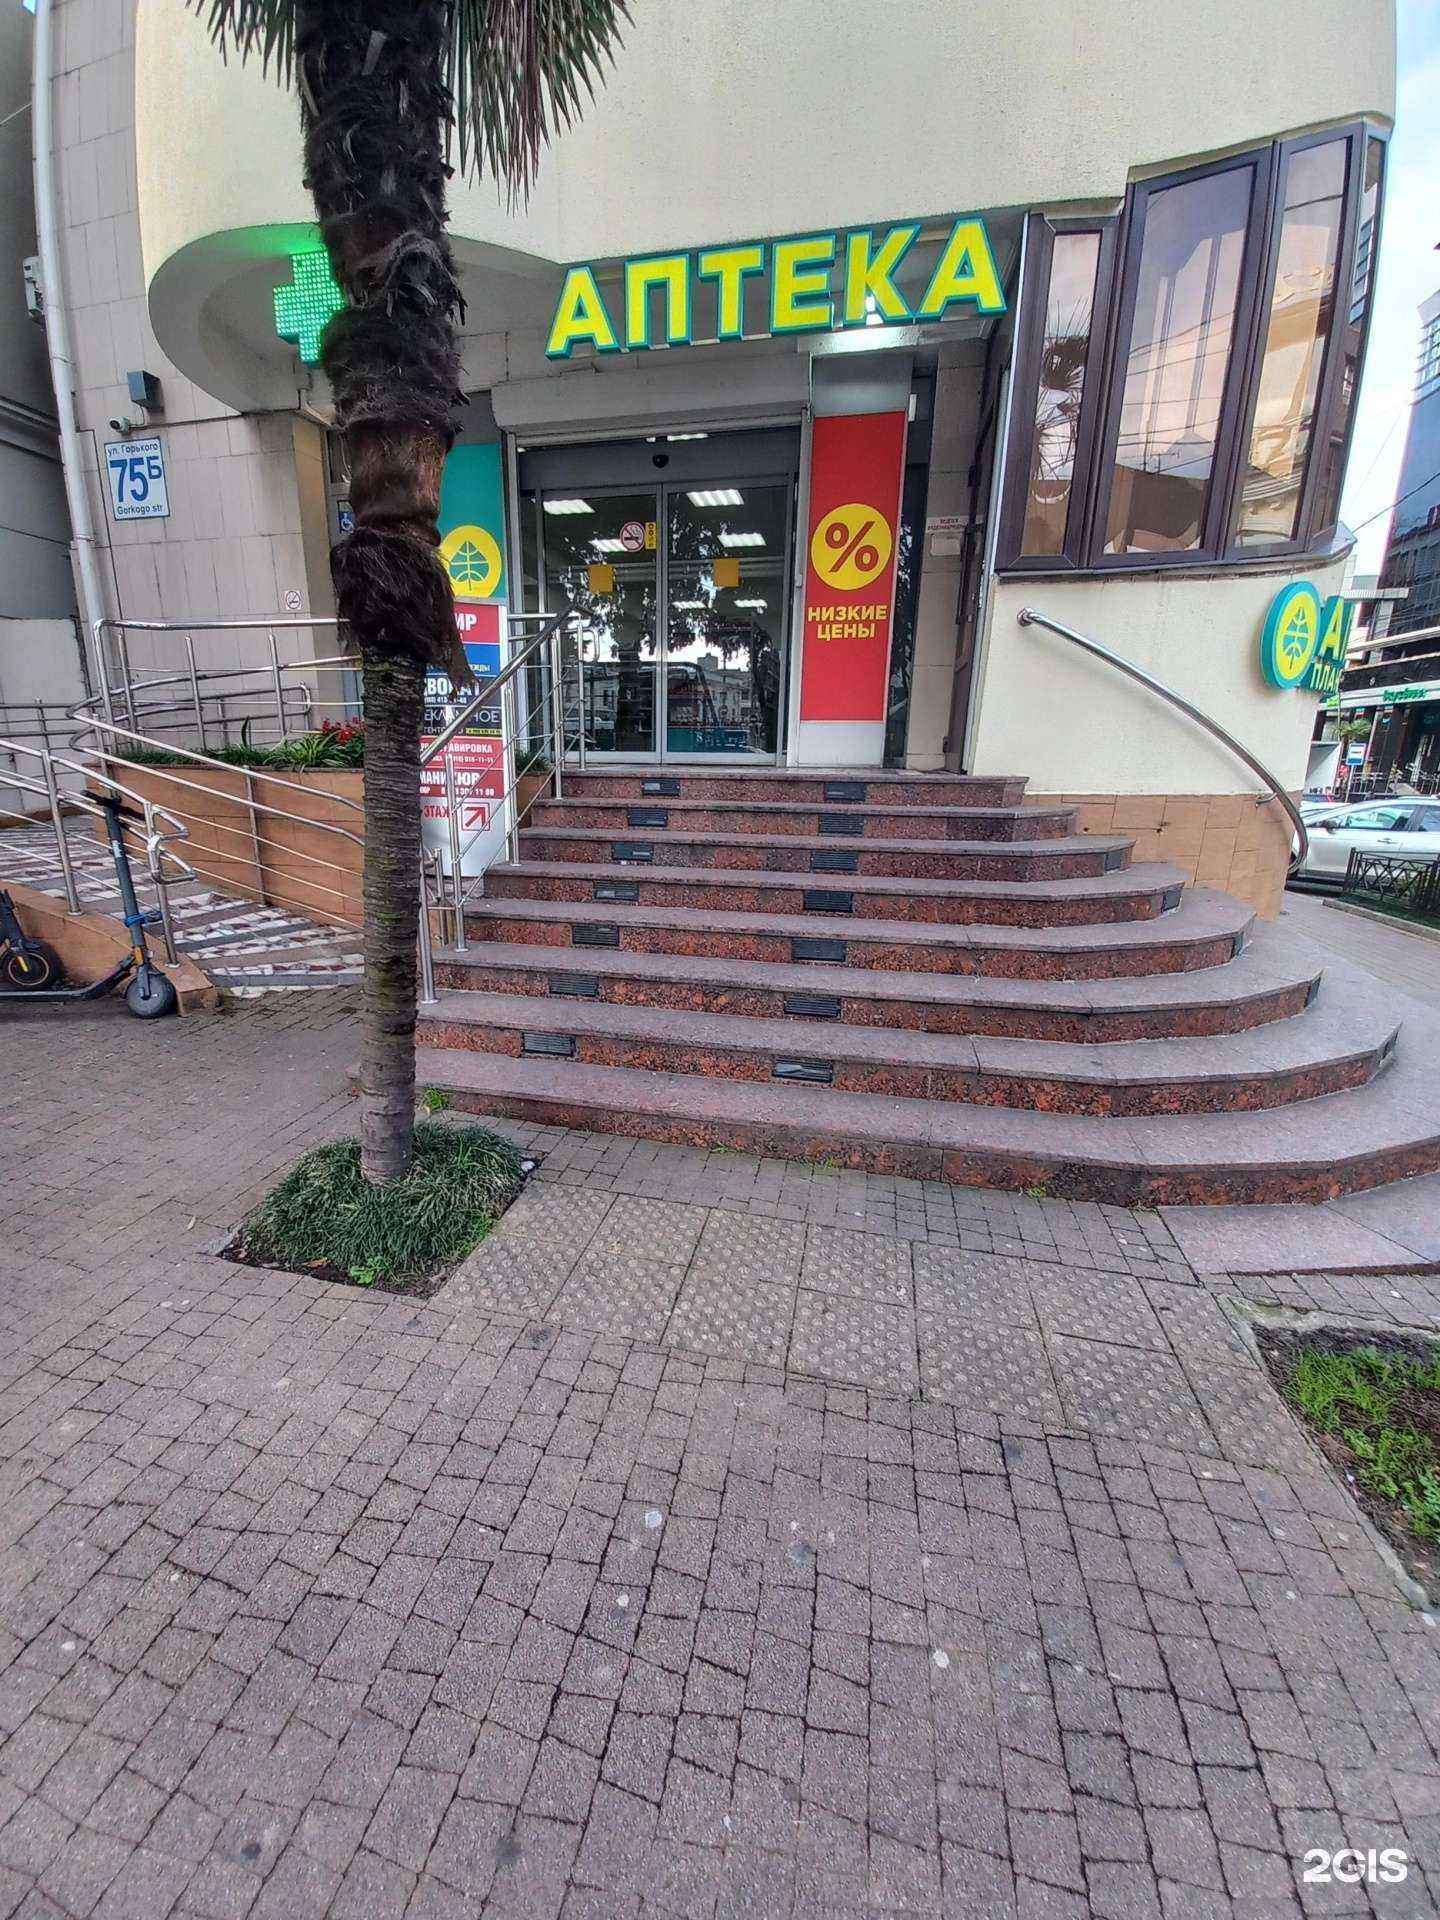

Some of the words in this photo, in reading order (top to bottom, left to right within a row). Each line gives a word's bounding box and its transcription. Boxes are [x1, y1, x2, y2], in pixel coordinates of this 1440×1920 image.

[545, 217, 1007, 361] АПТЕКА
[121, 442, 159, 453] Горького
[109, 455, 163, 502] 75Б
[117, 504, 151, 515] Gorkogo
[454, 613, 478, 631] ИР
[808, 605, 888, 622] НИЗКИЕ
[817, 623, 876, 641] ЦЕНЫ
[420, 771, 480, 786] МАНИЮР
